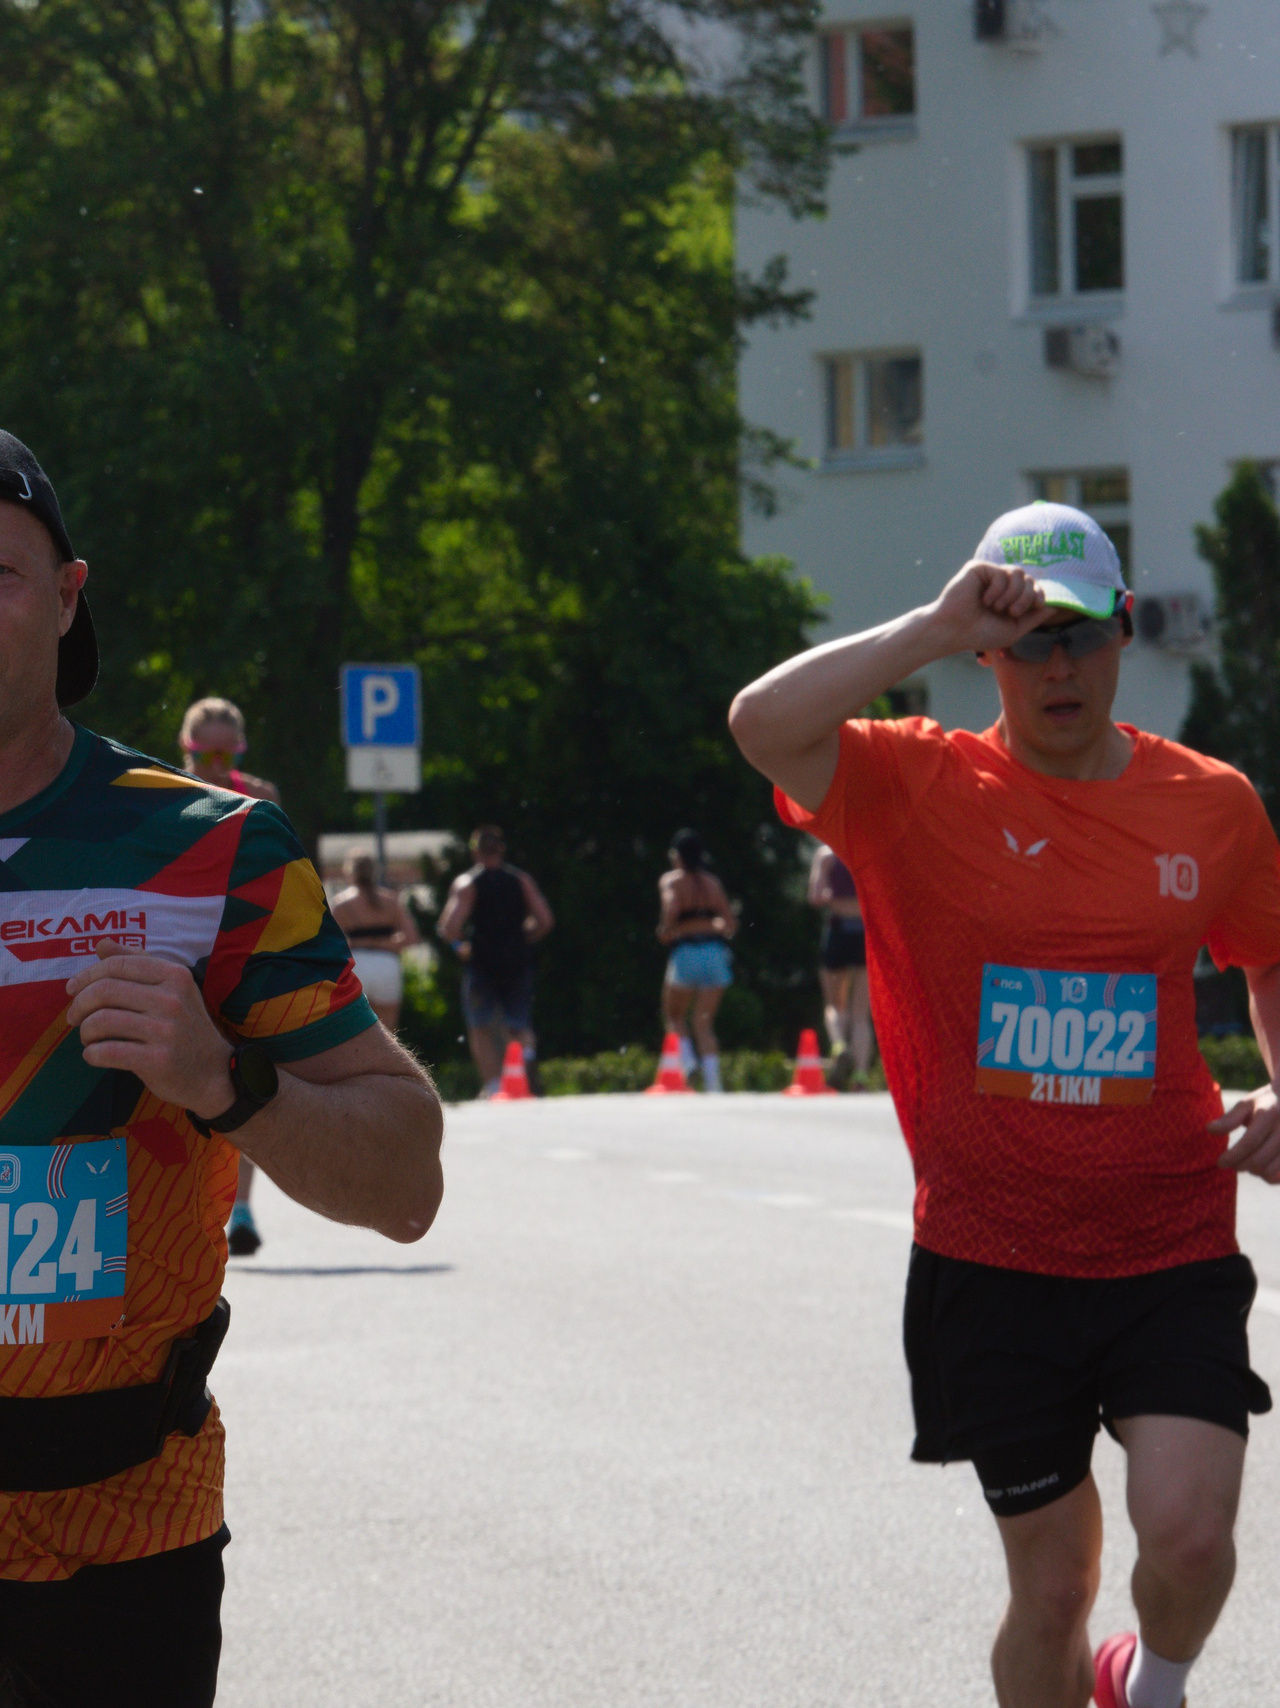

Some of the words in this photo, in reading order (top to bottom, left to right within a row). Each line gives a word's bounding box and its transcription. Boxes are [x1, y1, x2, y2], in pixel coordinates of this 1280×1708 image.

[1000, 531, 1086, 564] EVERLAST
[362, 675, 399, 739] P
[1154, 853, 1199, 901] 10
[70, 936, 143, 954] CLB
[1060, 976, 1088, 1003] 10
[991, 1001, 1145, 1072] 70022
[1030, 1073, 1102, 1106] 21.1KM
[1006, 1472, 1059, 1497] TRAINING
